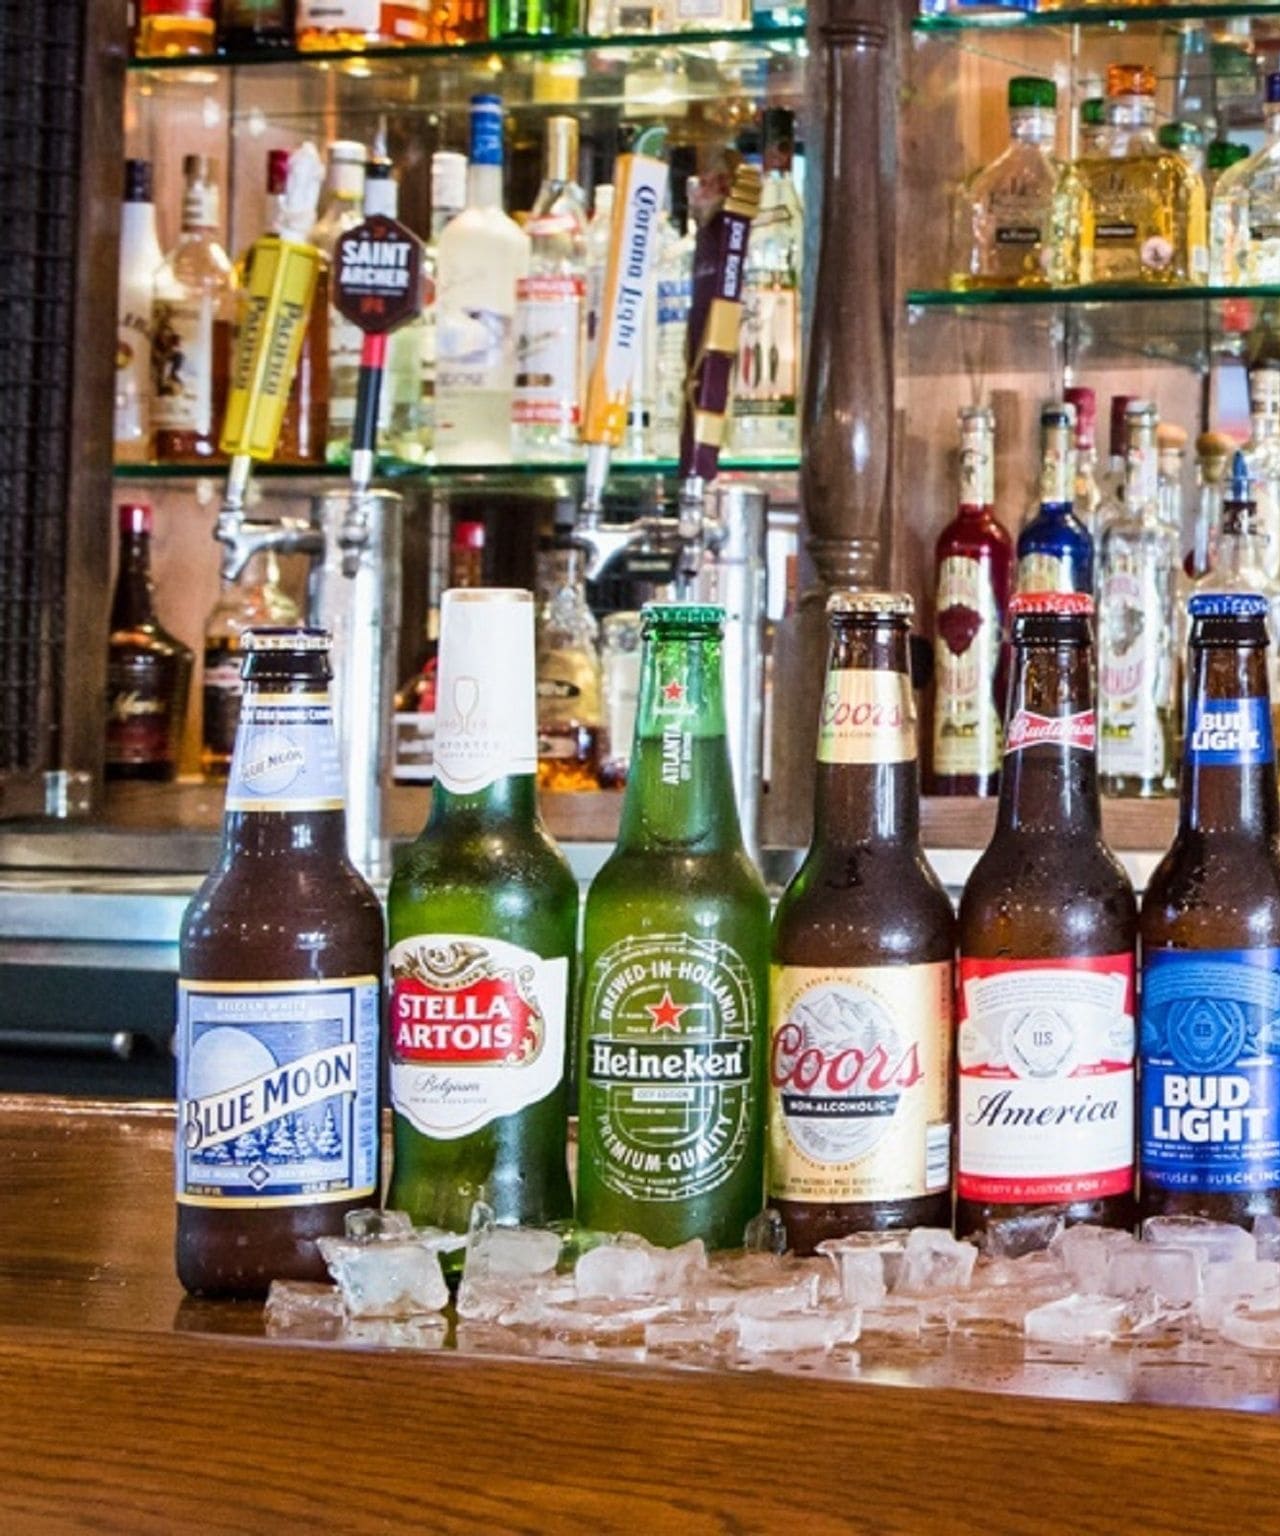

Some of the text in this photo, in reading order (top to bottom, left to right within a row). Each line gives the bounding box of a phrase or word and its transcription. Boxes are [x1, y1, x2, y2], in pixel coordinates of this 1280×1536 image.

[341, 240, 411, 266] SAINT
[1200, 711, 1250, 732] BUD
[661, 721, 681, 786] ATLANTA
[1192, 730, 1261, 751] LIGHT
[398, 993, 512, 1020] STELLA
[600, 964, 646, 1021] BREWED
[651, 959, 672, 979] IN
[678, 960, 738, 1022] HOLLAND
[396, 1022, 514, 1050] ARTOIS
[592, 1044, 743, 1081] Heineken
[771, 1022, 925, 1093] Coors
[185, 1051, 352, 1150] BLUE MOON
[965, 1089, 1119, 1127] America
[1163, 1074, 1251, 1109] BUD
[1152, 1106, 1271, 1143] LIGHT
[597, 1114, 662, 1173] PREMIUM
